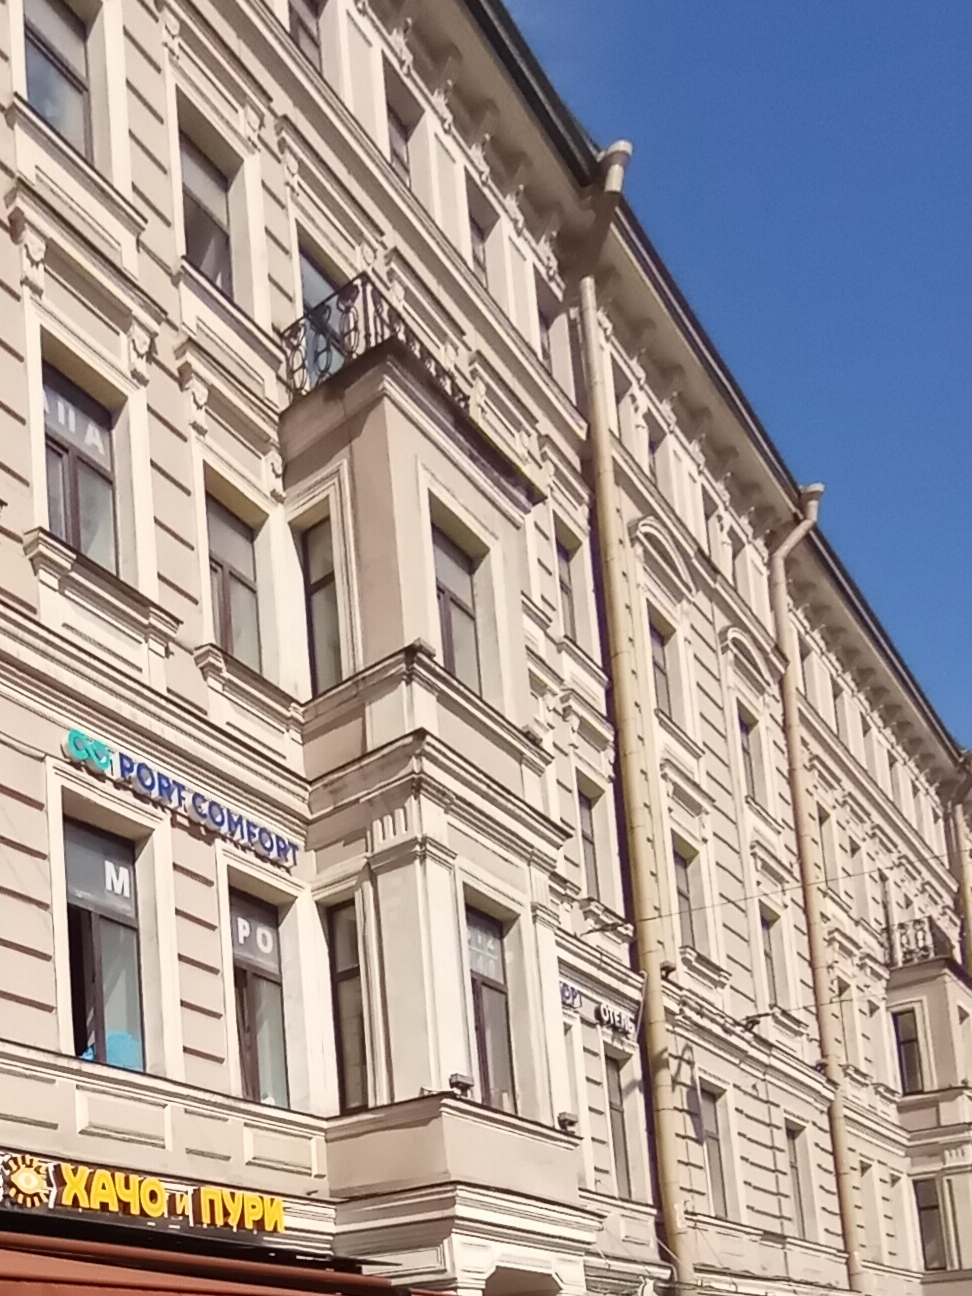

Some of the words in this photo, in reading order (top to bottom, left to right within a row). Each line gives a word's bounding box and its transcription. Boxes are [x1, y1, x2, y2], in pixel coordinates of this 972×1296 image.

[118, 751, 187, 808] PORT
[190, 790, 300, 868] COMFORT
[60, 1162, 167, 1219] ХАЧО
[199, 1186, 286, 1234] ПУРИ
